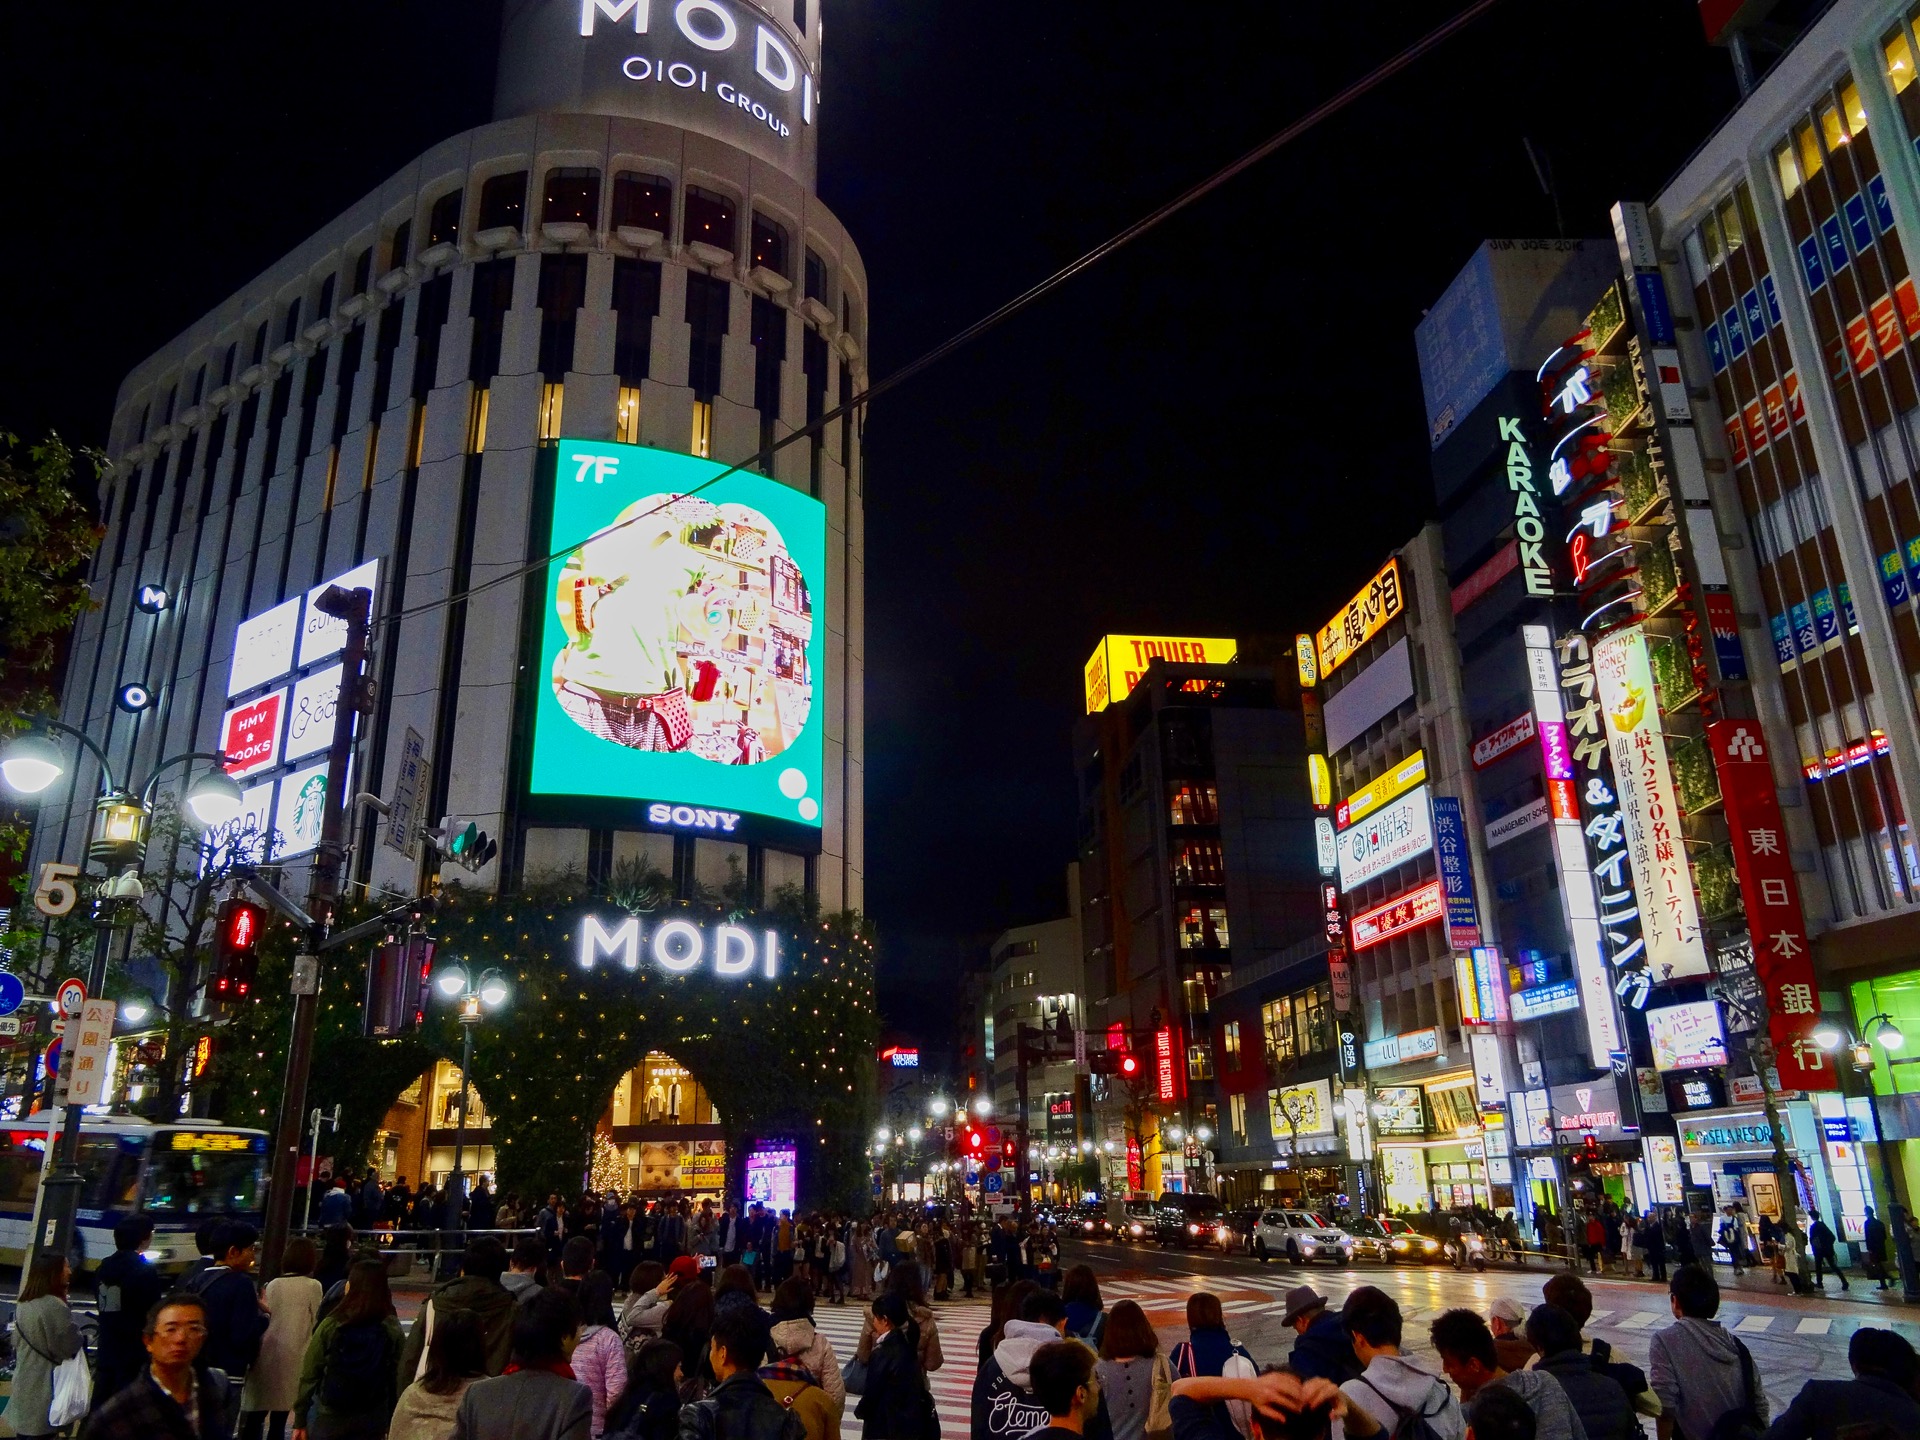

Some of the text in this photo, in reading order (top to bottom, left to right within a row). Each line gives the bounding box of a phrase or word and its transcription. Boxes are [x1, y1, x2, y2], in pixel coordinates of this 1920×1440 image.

[716, 83, 790, 138] GROUP
[571, 453, 620, 485] 7F
[1497, 416, 1555, 597] KARAOKE
[238, 711, 267, 732] HMV
[246, 732, 254, 742] &
[649, 804, 740, 831] SONY
[1337, 805, 1349, 823] 6F
[1491, 812, 1532, 840] MANAGEMENT
[1437, 815, 1464, 894] 渋谷整形
[34, 863, 81, 916] 5
[581, 916, 776, 978] MODI
[1747, 827, 1826, 1072] 東日本銀行
[64, 990, 81, 1008] 30
[76, 1006, 102, 1096] 公園通り
[892, 1053, 918, 1061] CULTURE
[1160, 1058, 1174, 1099] RECORDS
[1579, 1111, 1616, 1126] STREET
[682, 1157, 713, 1168] Teddy
